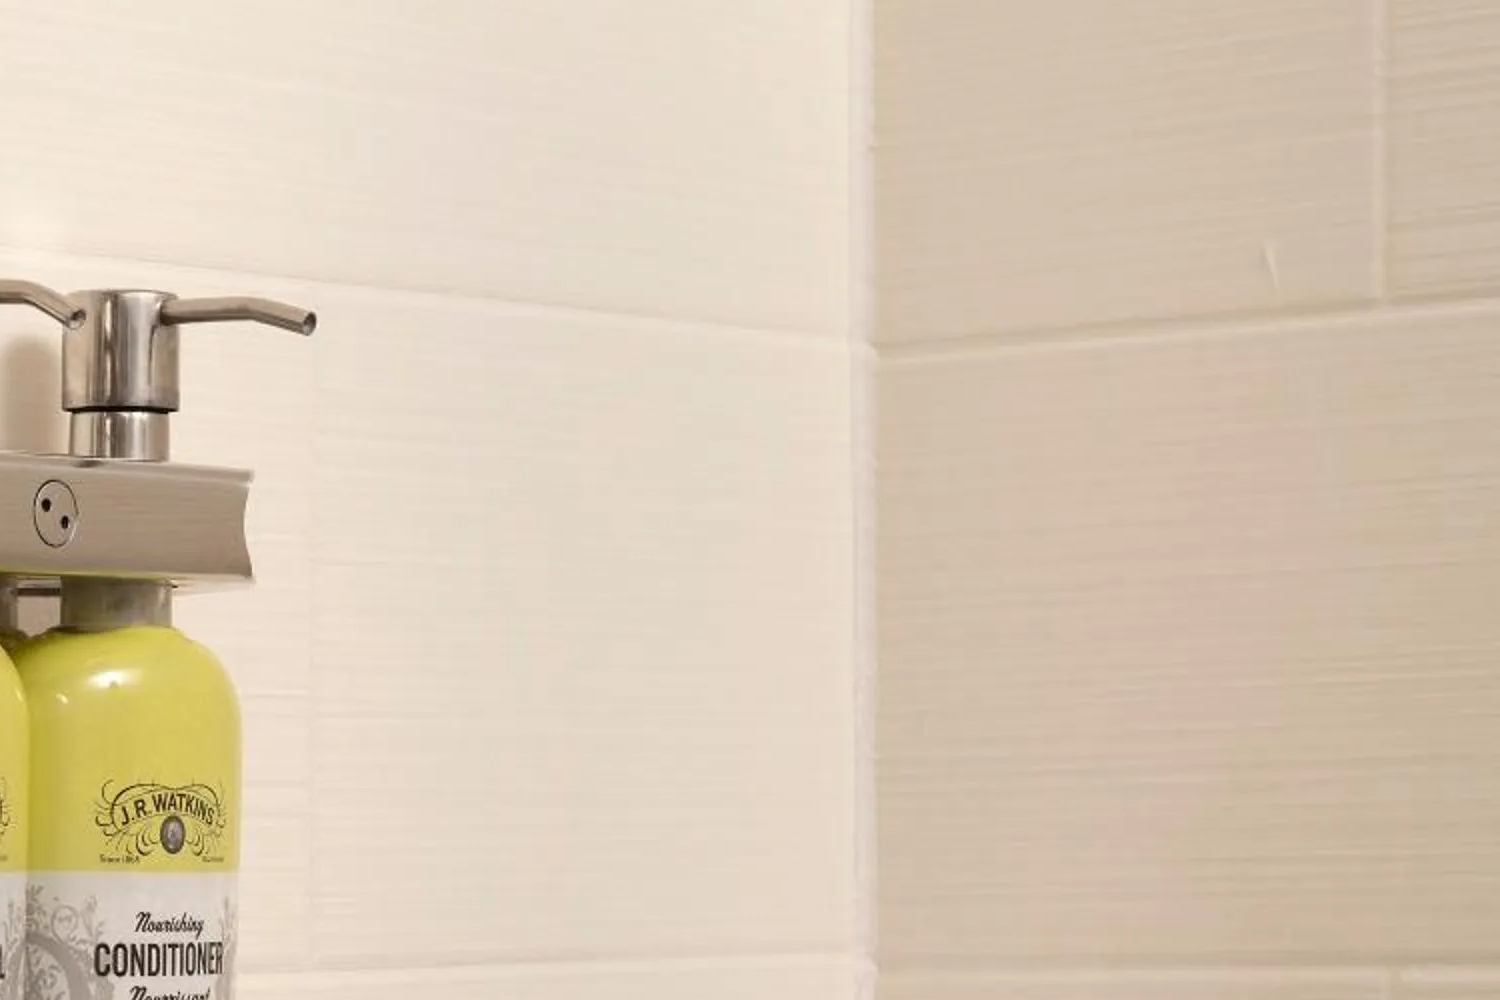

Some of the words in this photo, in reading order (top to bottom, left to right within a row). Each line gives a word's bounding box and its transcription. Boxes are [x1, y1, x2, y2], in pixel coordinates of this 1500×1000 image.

[121, 799, 152, 826] J.R.
[152, 793, 215, 825] WATKINS
[135, 911, 204, 940] Nourishing
[94, 942, 223, 977] CONDITIONER
